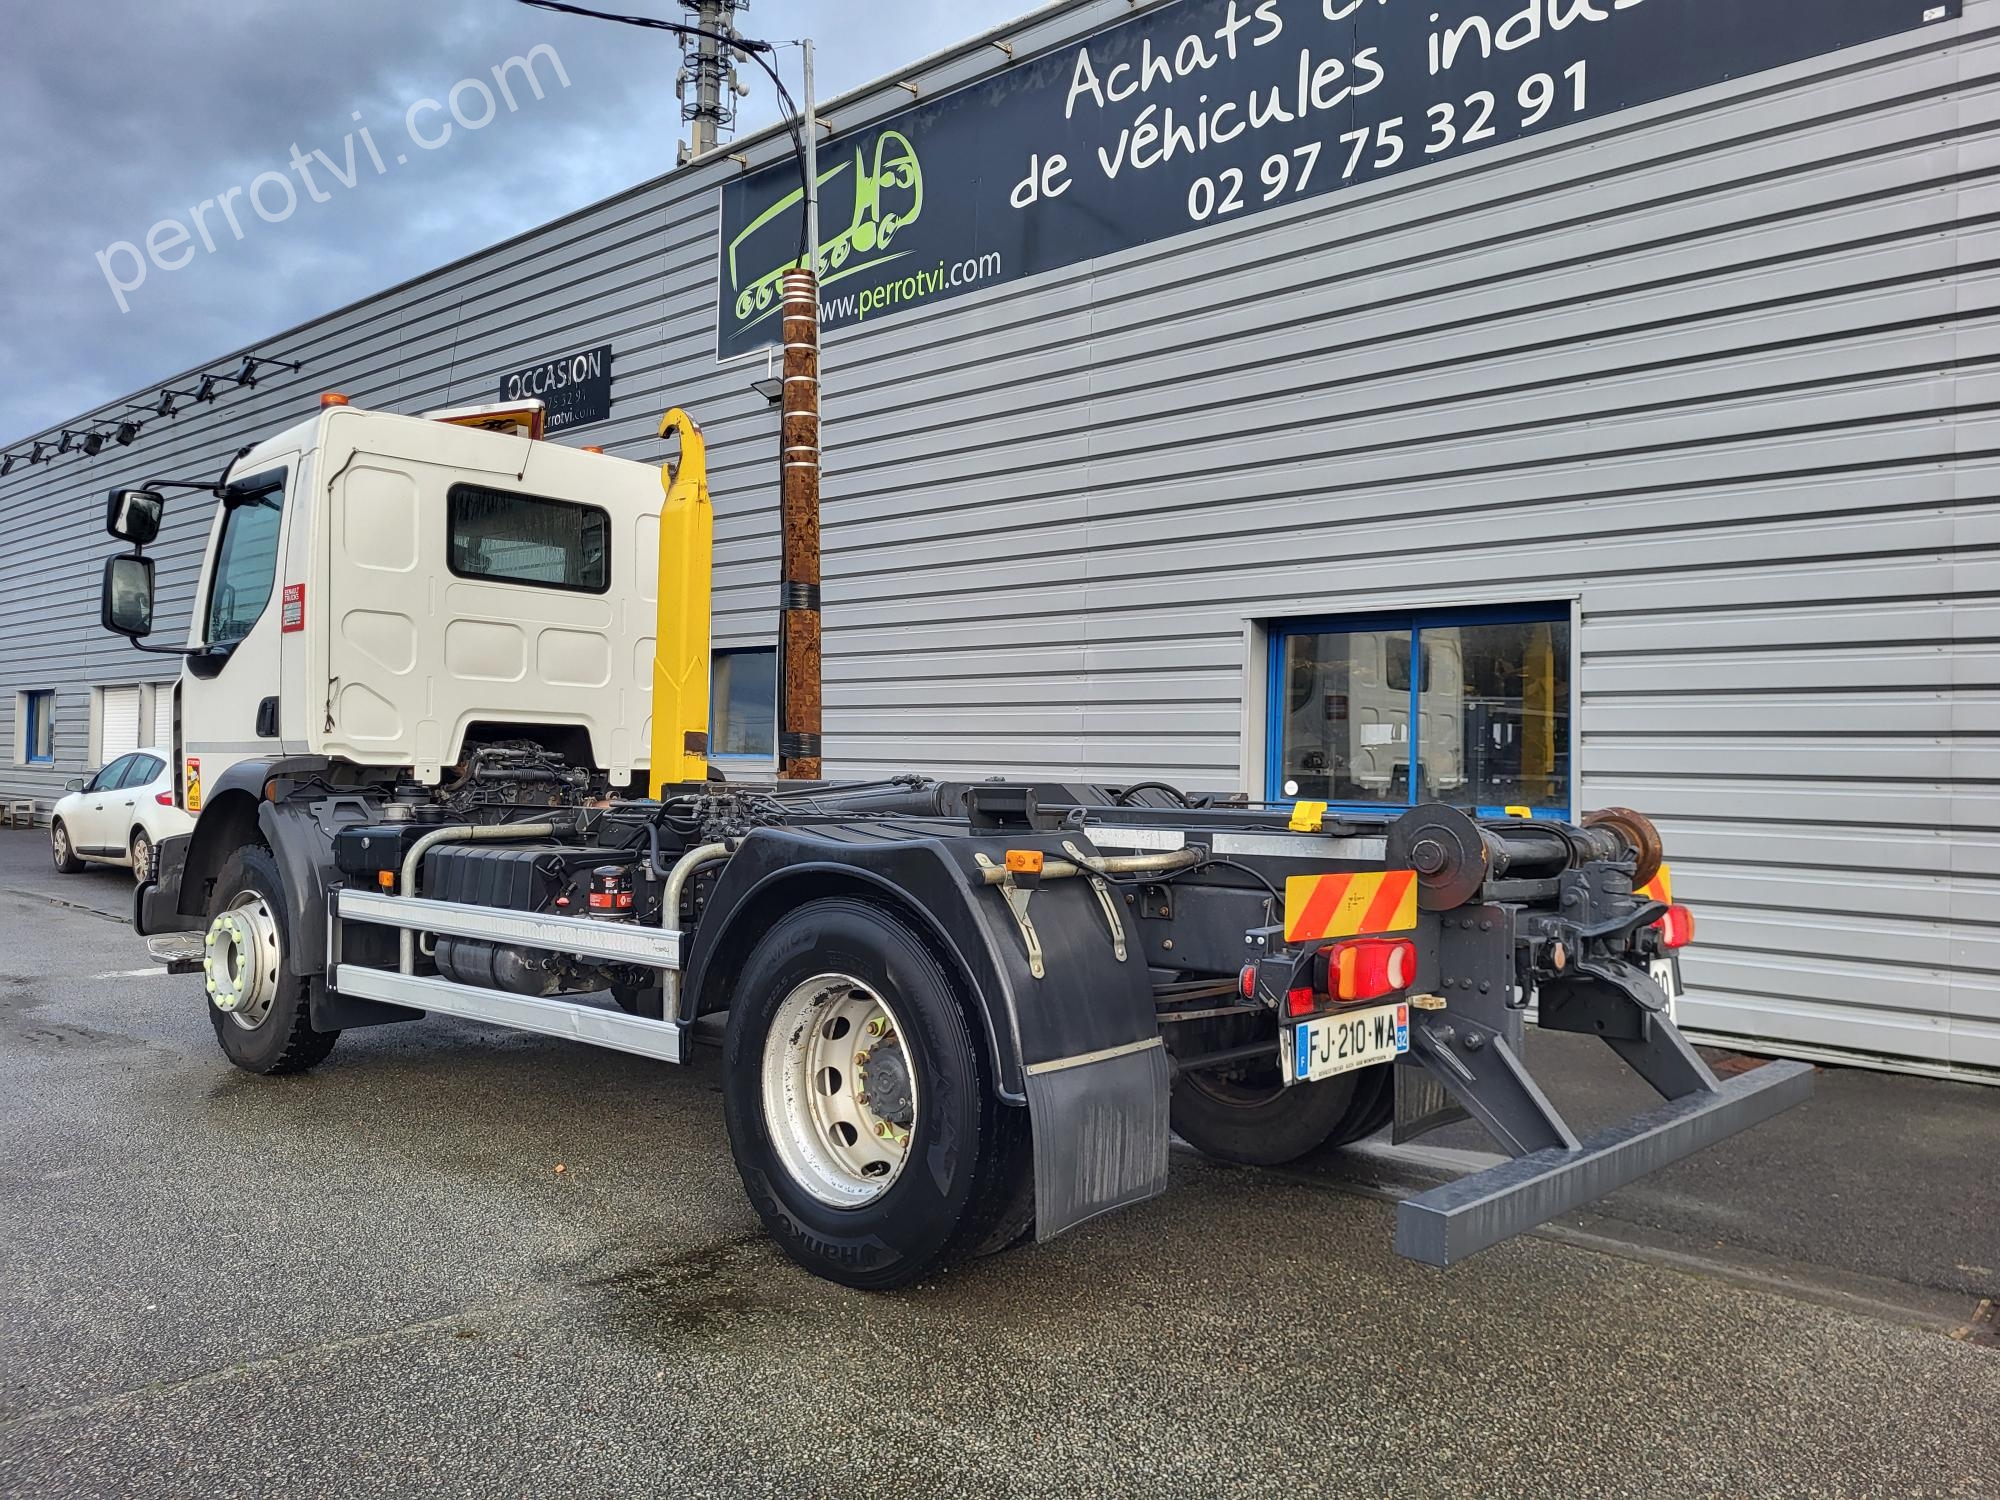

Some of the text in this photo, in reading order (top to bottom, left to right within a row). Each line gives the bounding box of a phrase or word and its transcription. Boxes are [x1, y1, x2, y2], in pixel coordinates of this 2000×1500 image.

[1010, 0, 1643, 209] de véhicules indu
[1065, 0, 1283, 119] Achats
[1188, 59, 1586, 221] 02 97 75 32 91
[819, 251, 1001, 323] ww.perrotvi.com
[508, 350, 601, 401] OCCASION
[1397, 1031, 1407, 1048] 32
